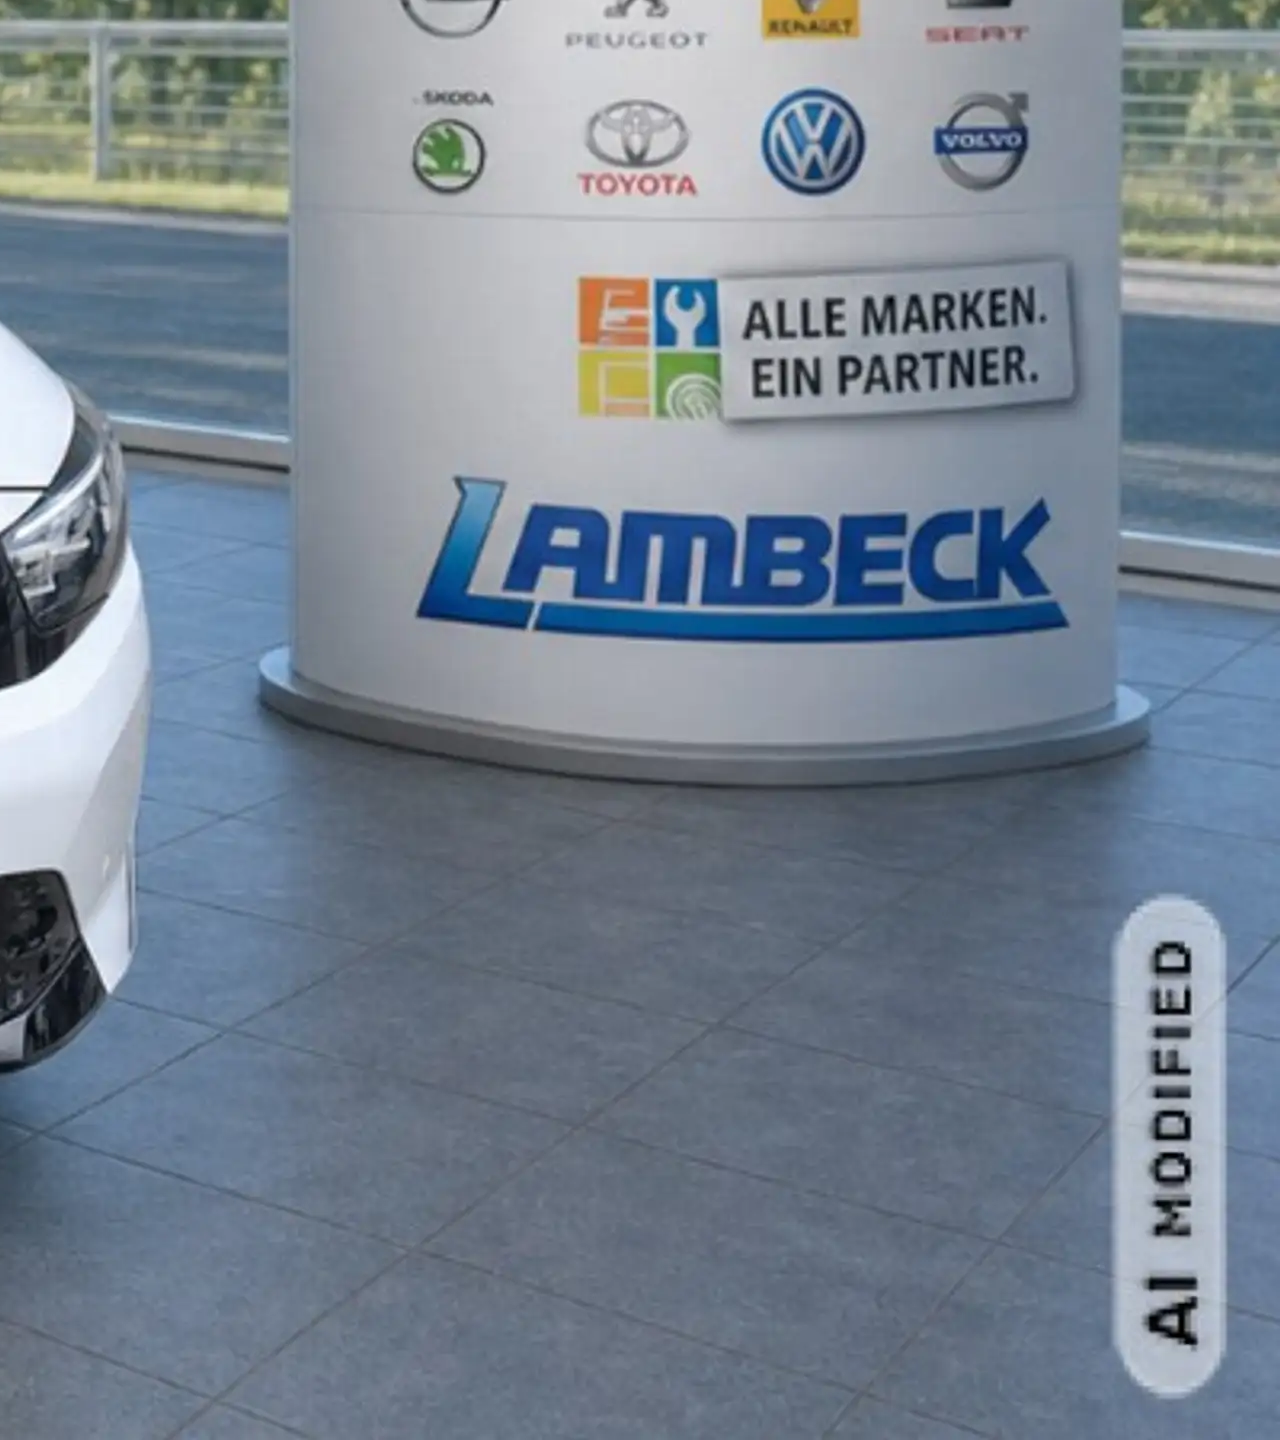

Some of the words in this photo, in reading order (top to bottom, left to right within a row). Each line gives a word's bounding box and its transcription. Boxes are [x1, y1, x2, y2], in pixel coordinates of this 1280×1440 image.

[768, 18, 853, 35] RENAULT
[565, 32, 708, 48] PEUGEOT
[941, 132, 1023, 148] VOLVO
[578, 172, 697, 196] TOYOTA
[742, 296, 847, 340] ALLE
[861, 286, 1048, 337] MARKEN.
[751, 356, 823, 398] EIN
[838, 344, 1040, 394] PARTNER.
[416, 475, 1054, 632] LAMBECK
